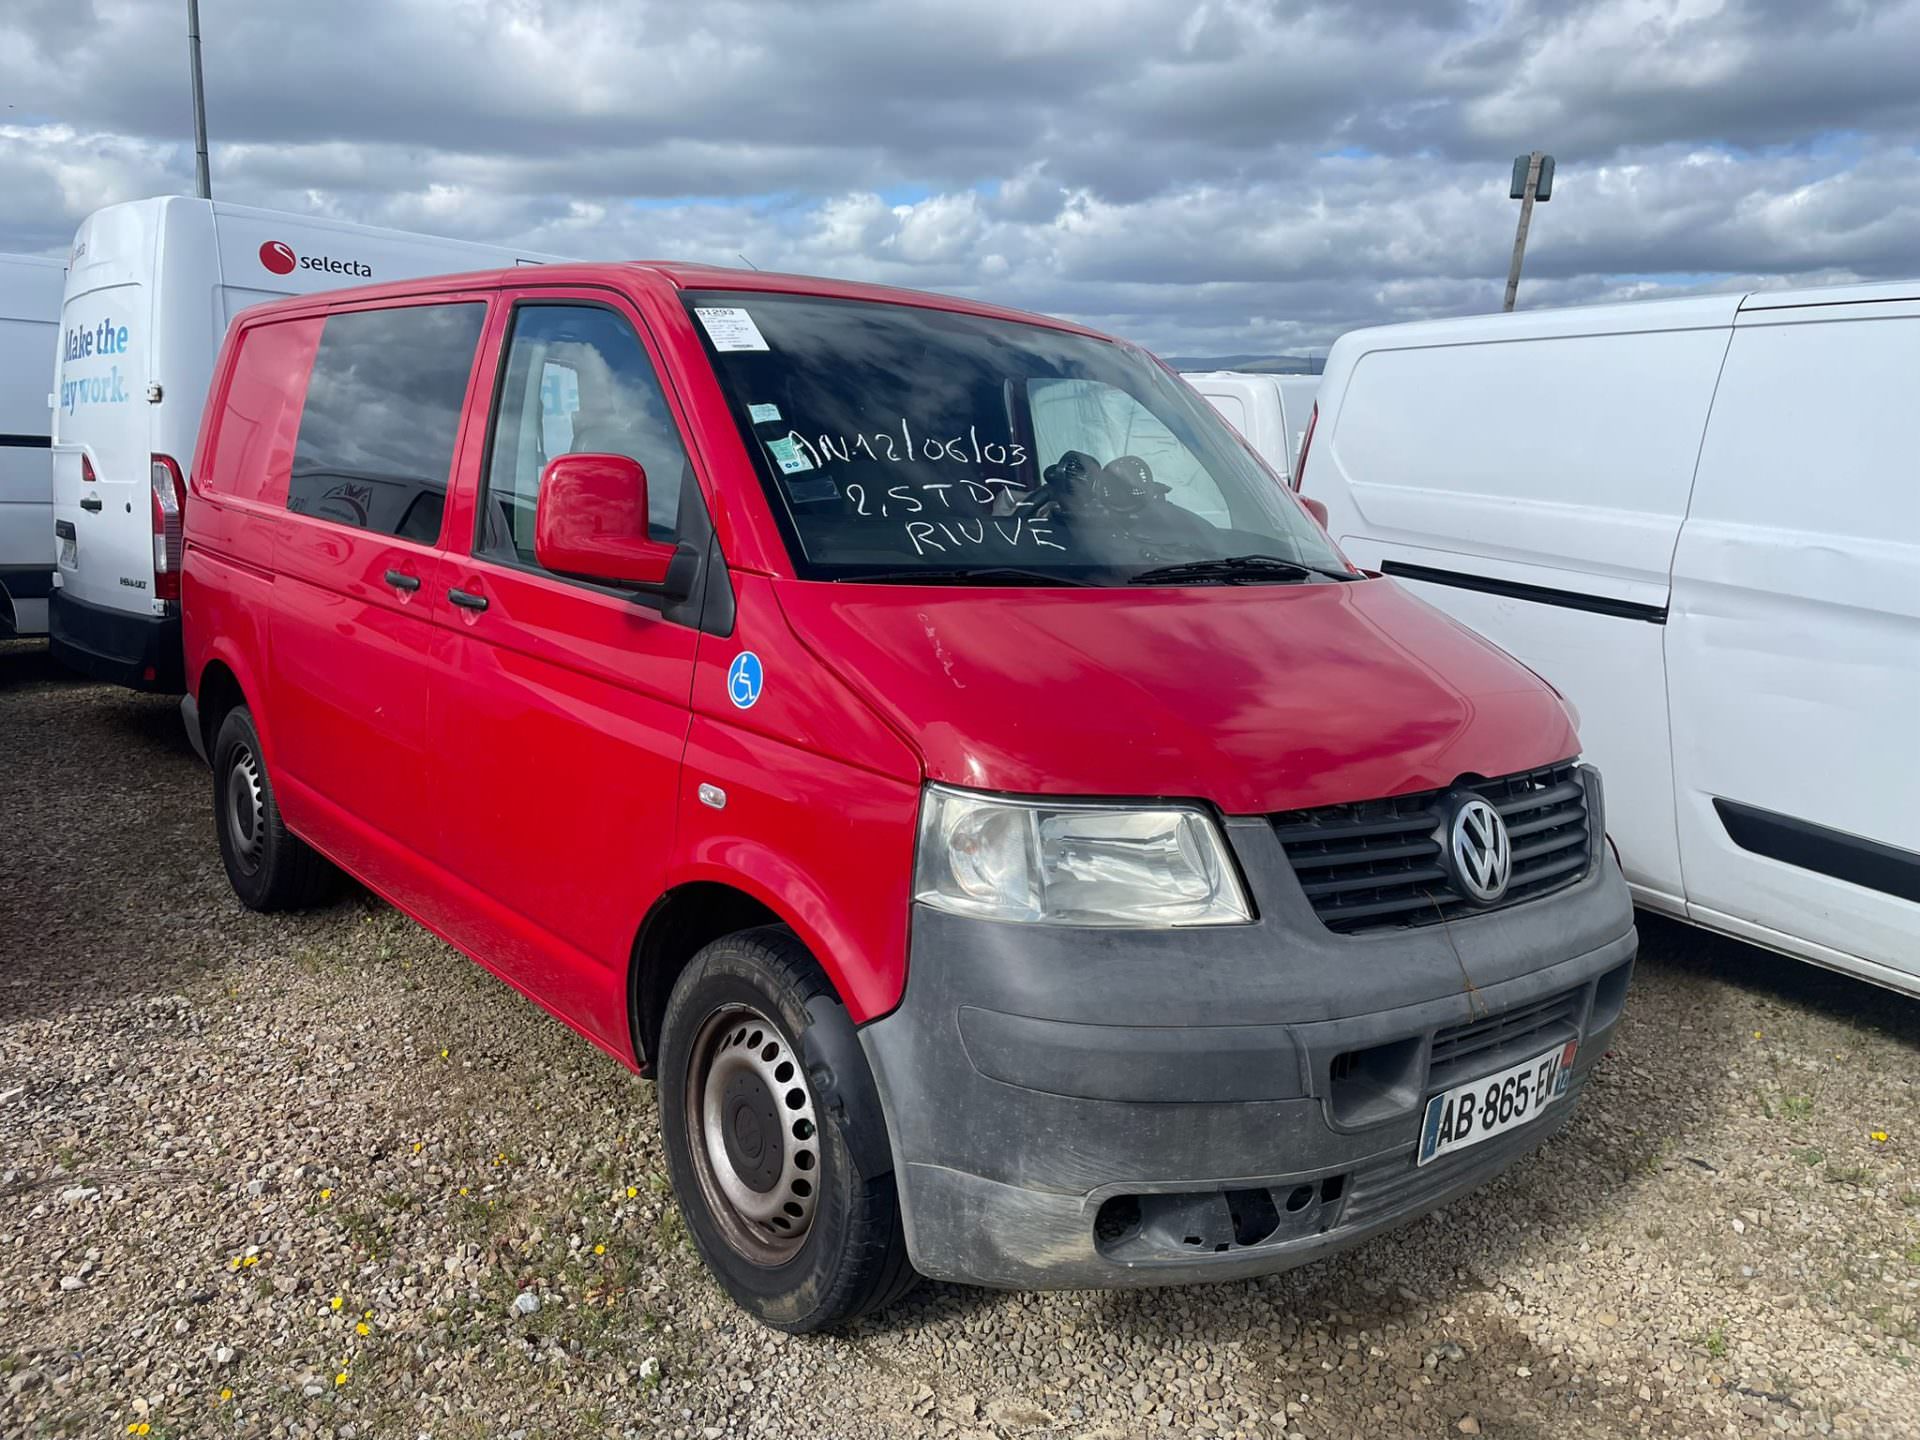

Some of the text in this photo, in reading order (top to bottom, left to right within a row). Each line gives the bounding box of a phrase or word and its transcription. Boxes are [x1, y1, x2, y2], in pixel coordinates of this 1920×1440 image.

[300, 254, 372, 278] selecta
[64, 317, 128, 363] Make the
